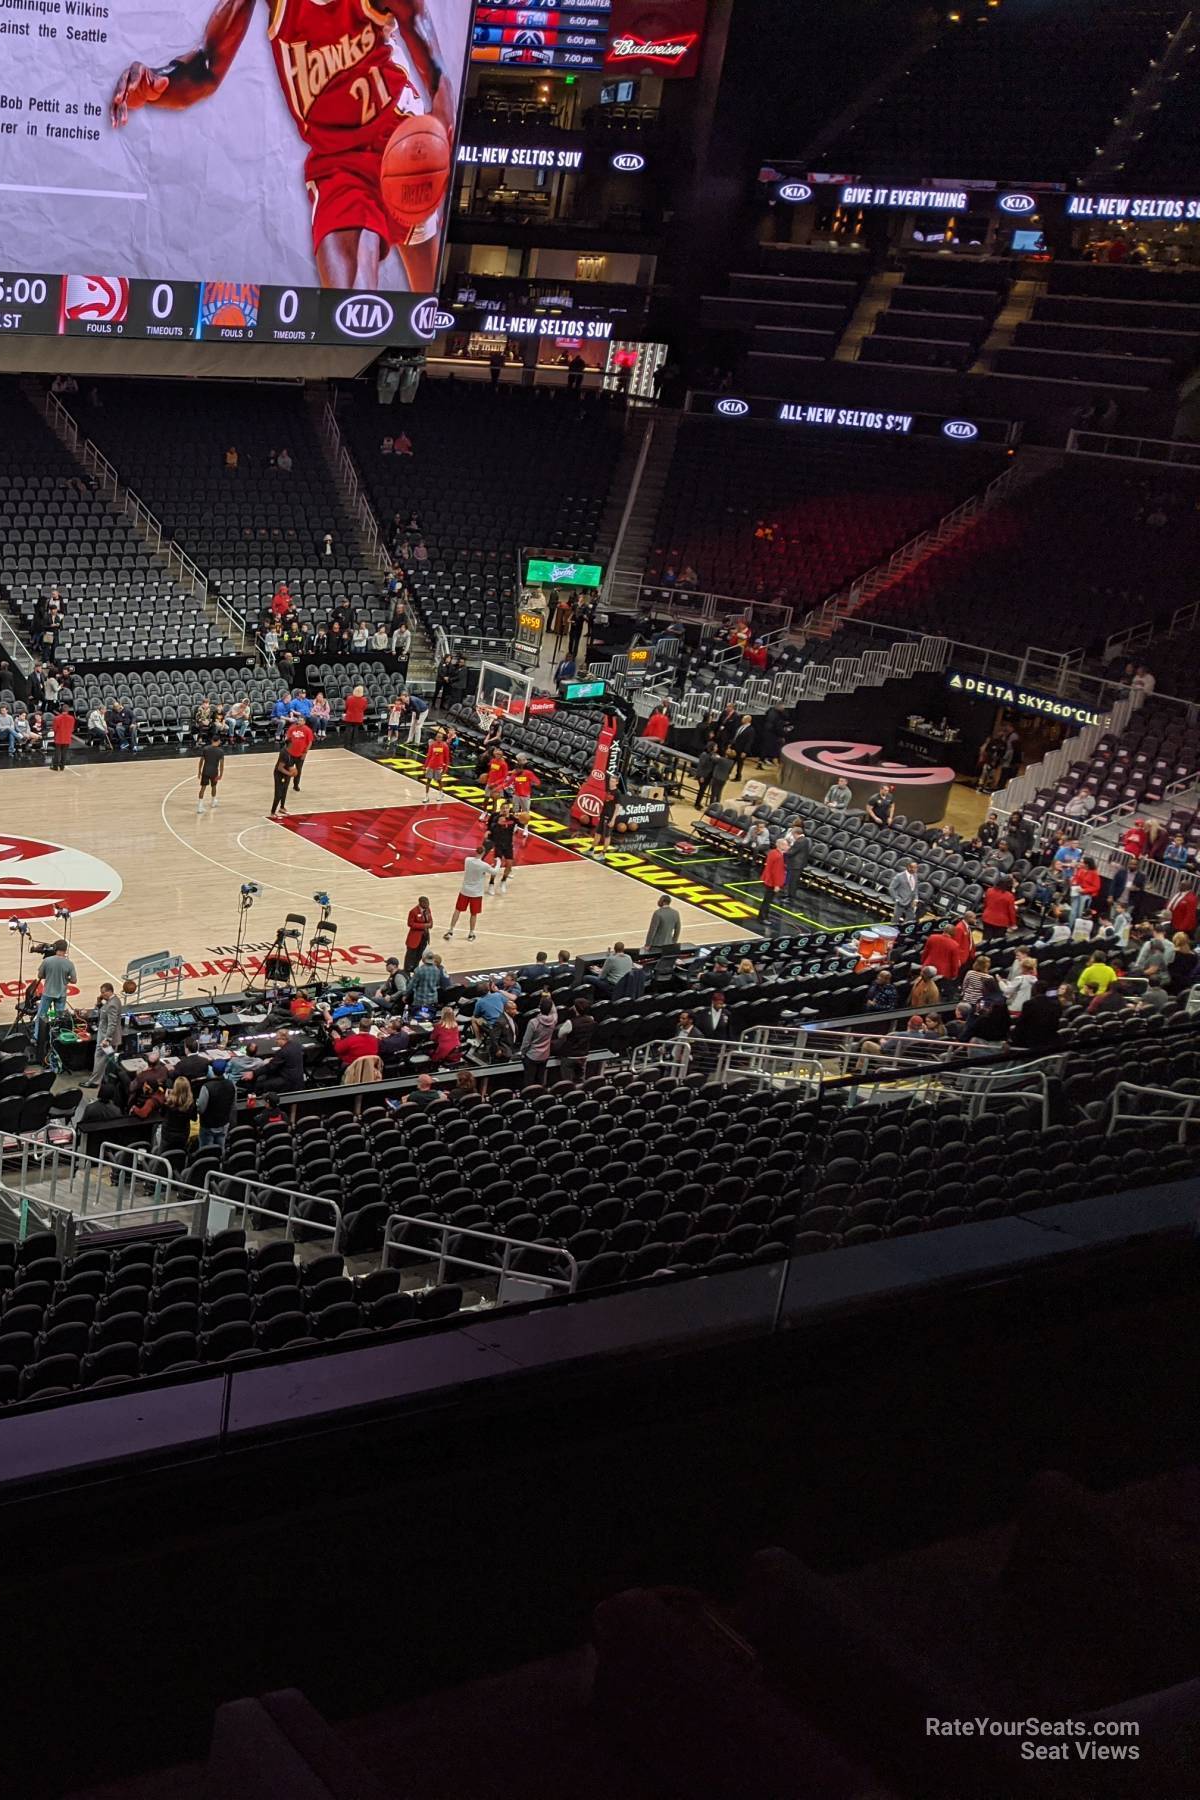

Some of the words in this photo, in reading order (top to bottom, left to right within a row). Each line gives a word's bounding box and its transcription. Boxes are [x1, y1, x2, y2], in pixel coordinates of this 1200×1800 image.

[65, 2, 110, 18] Wilkins
[569, 17, 585, 25] 6:00
[586, 19, 599, 27] pm
[38, 23, 57, 38] the
[66, 26, 108, 44] Seattle
[583, 39, 596, 47] pm
[613, 39, 688, 57] Budweiser
[280, 22, 376, 118] Hawks
[580, 57, 593, 65] pm
[0, 94, 22, 111] Bob
[28, 97, 61, 114] Pettit
[64, 102, 79, 115] as
[83, 101, 102, 117] the
[349, 66, 392, 126] 21
[26, 121, 38, 136] in
[45, 123, 101, 141] franchise
[458, 146, 509, 164] ALL-NEW
[510, 148, 555, 166] SELTOS
[556, 152, 583, 168] SUV
[843, 187, 873, 205] GIVE
[873, 189, 889, 206] IT
[888, 190, 967, 209] EVERYTHING
[1068, 197, 1130, 215] ALL-NEW
[1130, 199, 1185, 218] SELTOS
[151, 283, 174, 319] 0
[278, 290, 298, 324] 0
[86, 323, 112, 333] FOULS
[116, 325, 123, 334] 0
[146, 326, 184, 336] TIMEOUTS
[188, 327, 195, 336] 7
[220, 330, 244, 338] FOULS
[247, 330, 253, 339] 0
[273, 331, 307, 340] TIMEOUTS
[310, 332, 315, 340] 7
[485, 315, 538, 334] ALL-NEW
[539, 318, 584, 337] SELTOS
[586, 321, 613, 338] SUV
[780, 404, 835, 424] ALL-NEW
[837, 408, 882, 429] SELTOS
[964, 678, 1014, 702] DELTA
[606, 740, 620, 777] xfinity
[628, 815, 650, 824] ARENA
